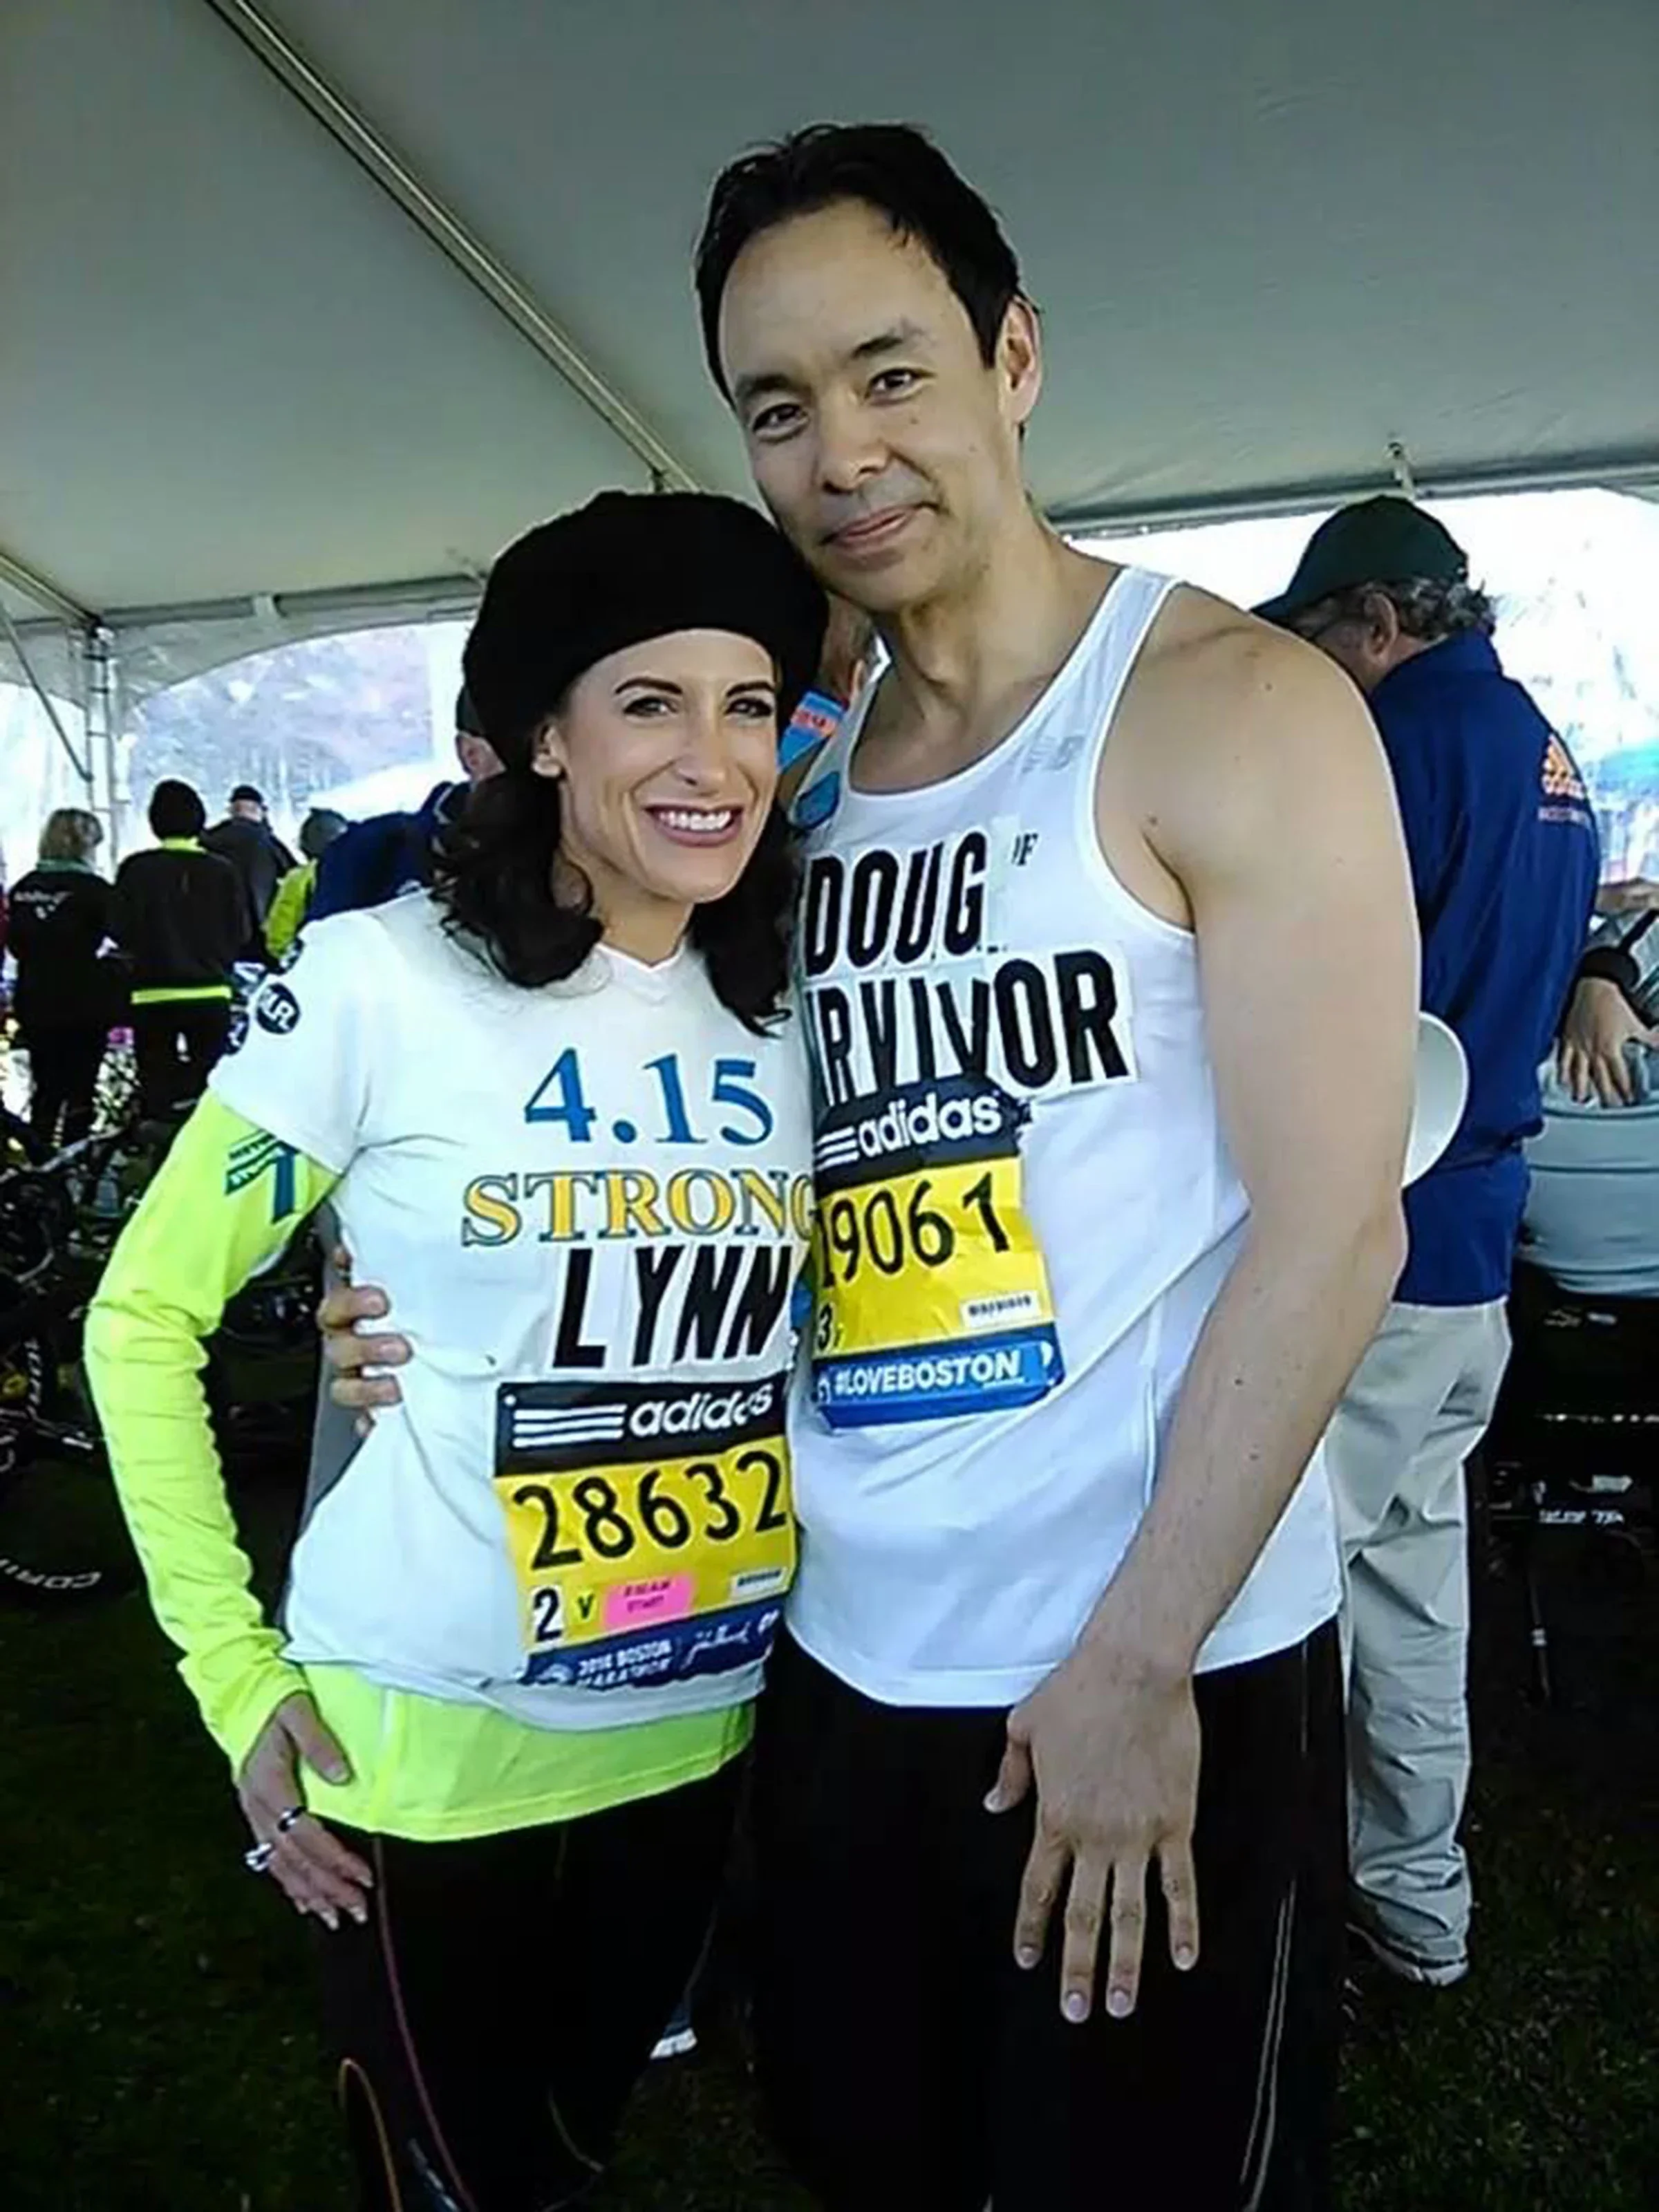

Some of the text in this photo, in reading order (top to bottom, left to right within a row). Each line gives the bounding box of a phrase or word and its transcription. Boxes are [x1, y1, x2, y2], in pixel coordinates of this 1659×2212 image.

[805, 832, 986, 976] DOUG
[807, 950, 1129, 1106] RVIVOR
[525, 1047, 773, 1145] 4.15
[859, 1091, 1002, 1157] adidas
[813, 1171, 1009, 1288] 19061
[553, 1245, 792, 1368] LYNN
[513, 1450, 787, 1571] 28632
[533, 1588, 562, 1642] 2
